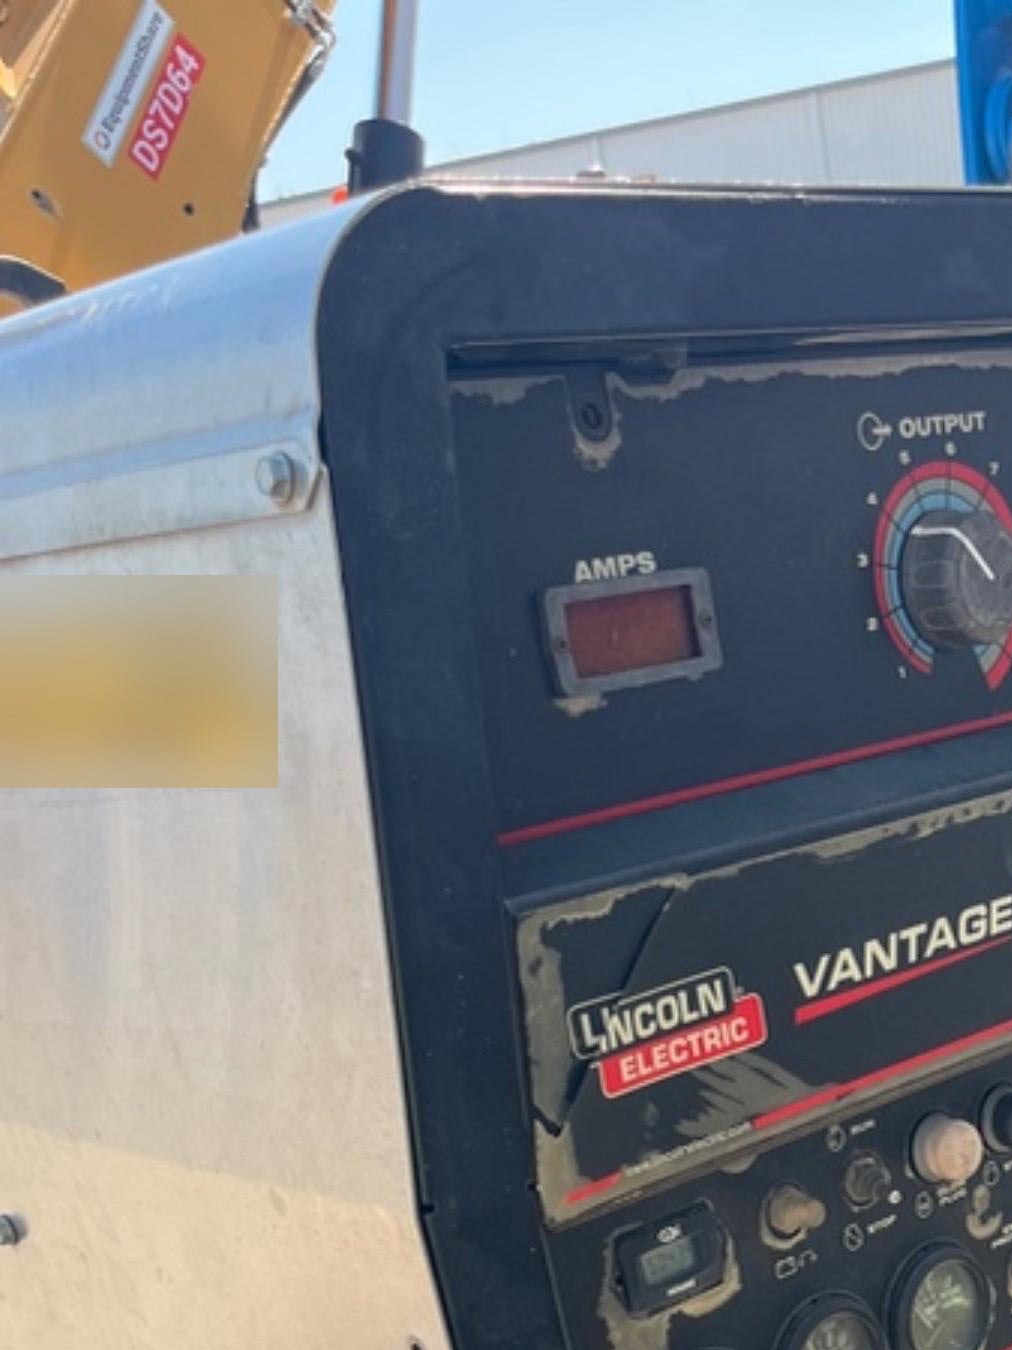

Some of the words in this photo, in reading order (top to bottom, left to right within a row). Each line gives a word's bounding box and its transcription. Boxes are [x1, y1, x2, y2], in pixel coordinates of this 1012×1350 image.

[131, 44, 200, 172] DS7D64
[899, 411, 987, 439] OUTPUT
[574, 550, 656, 586] AMPS
[619, 1016, 749, 1083] ELECTRIC
